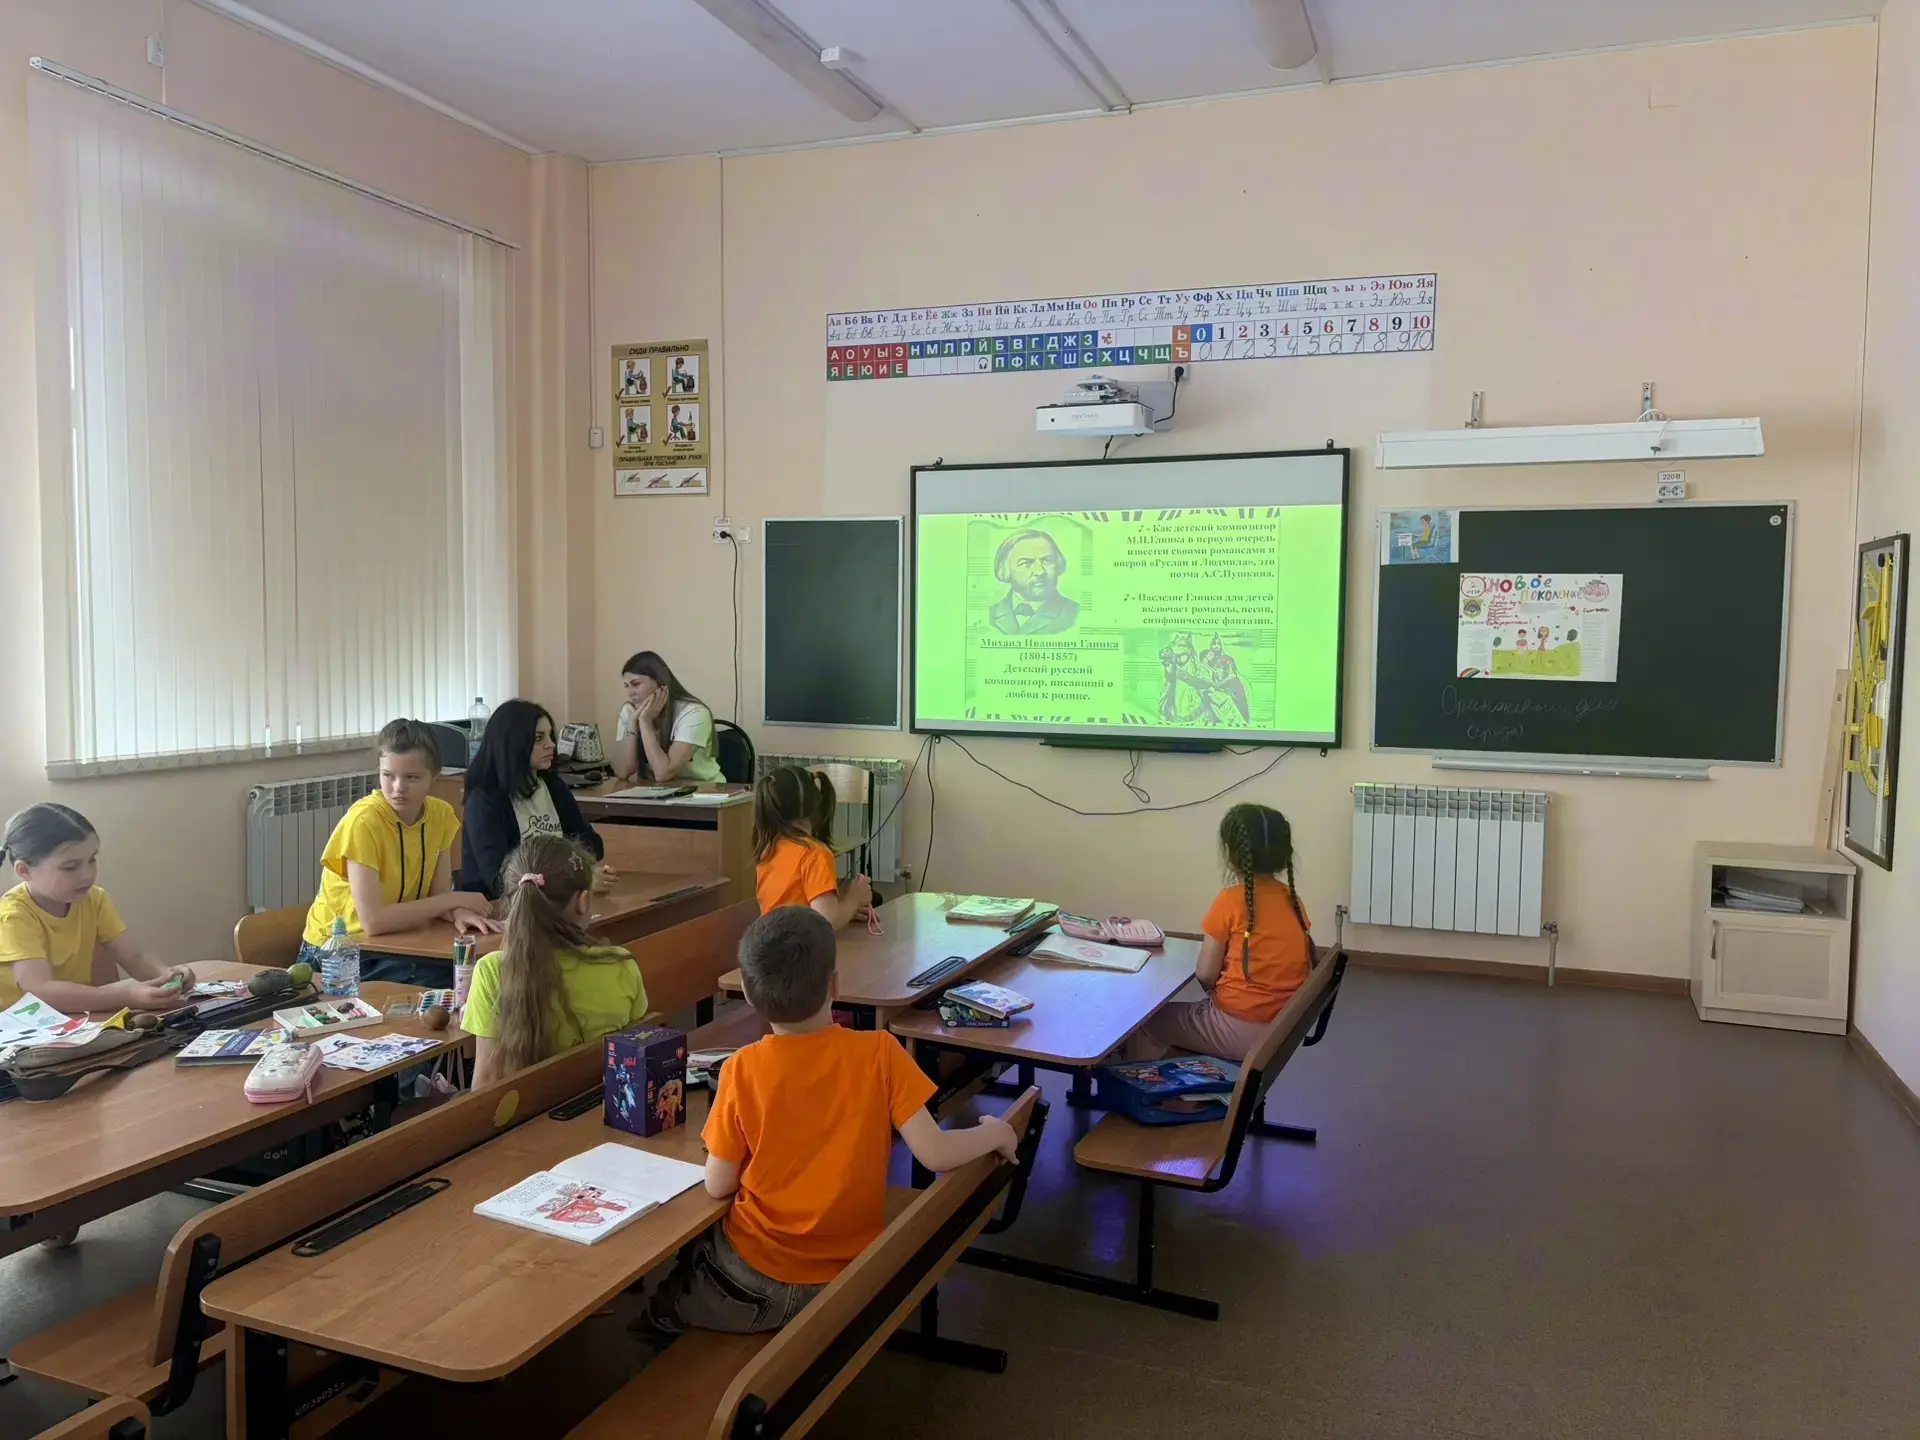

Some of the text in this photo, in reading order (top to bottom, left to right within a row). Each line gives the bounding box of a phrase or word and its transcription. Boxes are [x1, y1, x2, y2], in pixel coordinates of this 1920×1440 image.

[1030, 304, 1045, 313] Лл
[1047, 302, 1064, 312] Мм
[1066, 301, 1081, 310] Нн
[1084, 300, 1097, 309] Оо
[1102, 299, 1117, 308] Пп
[1121, 298, 1135, 308] Рр
[1139, 296, 1151, 305] Сс
[1158, 295, 1171, 304] Тт
[1176, 294, 1190, 304] Уу
[1193, 293, 1212, 303] Фф
[1216, 291, 1232, 300] Хх
[831, 350, 839, 360] А
[846, 350, 855, 359] О
[863, 349, 873, 358] У
[877, 348, 888, 358] Ы
[896, 347, 904, 356] Э
[911, 346, 920, 356] Н
[927, 345, 938, 355] М
[944, 343, 954, 354] Л
[978, 340, 988, 352] Й
[995, 340, 1004, 350] Б
[1013, 338, 1023, 349] В
[1032, 337, 1039, 347] Г
[1047, 336, 1058, 349] Д
[1063, 335, 1077, 347] Ж
[1085, 334, 1093, 345] З
[1196, 327, 1206, 340] 0
[1218, 327, 1226, 339] 1
[1239, 325, 1248, 338] 2
[1260, 324, 1270, 337] 3
[1280, 323, 1289, 335] 4
[1303, 321, 1312, 334] 5
[1324, 320, 1334, 333] 6
[1347, 319, 1357, 332] 7
[1369, 318, 1379, 331] 8
[1392, 316, 1402, 330] 9
[1413, 315, 1430, 329] 10
[649, 345, 689, 354] ПРАВИЛЬНО
[1153, 523, 1276, 532] Как детский композитор
[1197, 536, 1233, 544] первую
[1236, 535, 1275, 543] очередь
[1210, 548, 1266, 556] романсами
[1113, 560, 1147, 569] оперой
[1150, 559, 1189, 568] «Руслан
[1200, 558, 1256, 567] Людмила»,
[1202, 570, 1275, 579] А.С.Пушкина.
[1246, 593, 1273, 602] детей
[1192, 606, 1239, 614] романсы,
[1241, 606, 1273, 614] песни,
[1143, 617, 1273, 626] симфонические фантазии.
[981, 638, 1119, 648] Михаил Иванович Глинка
[1019, 652, 1077, 661] (1804-1857)
[1004, 664, 1093, 675] Детский русский
[984, 678, 1048, 688] композитор,
[1050, 679, 1104, 688] писавший
[1005, 690, 1039, 699] любви
[1052, 692, 1091, 700] родине.
